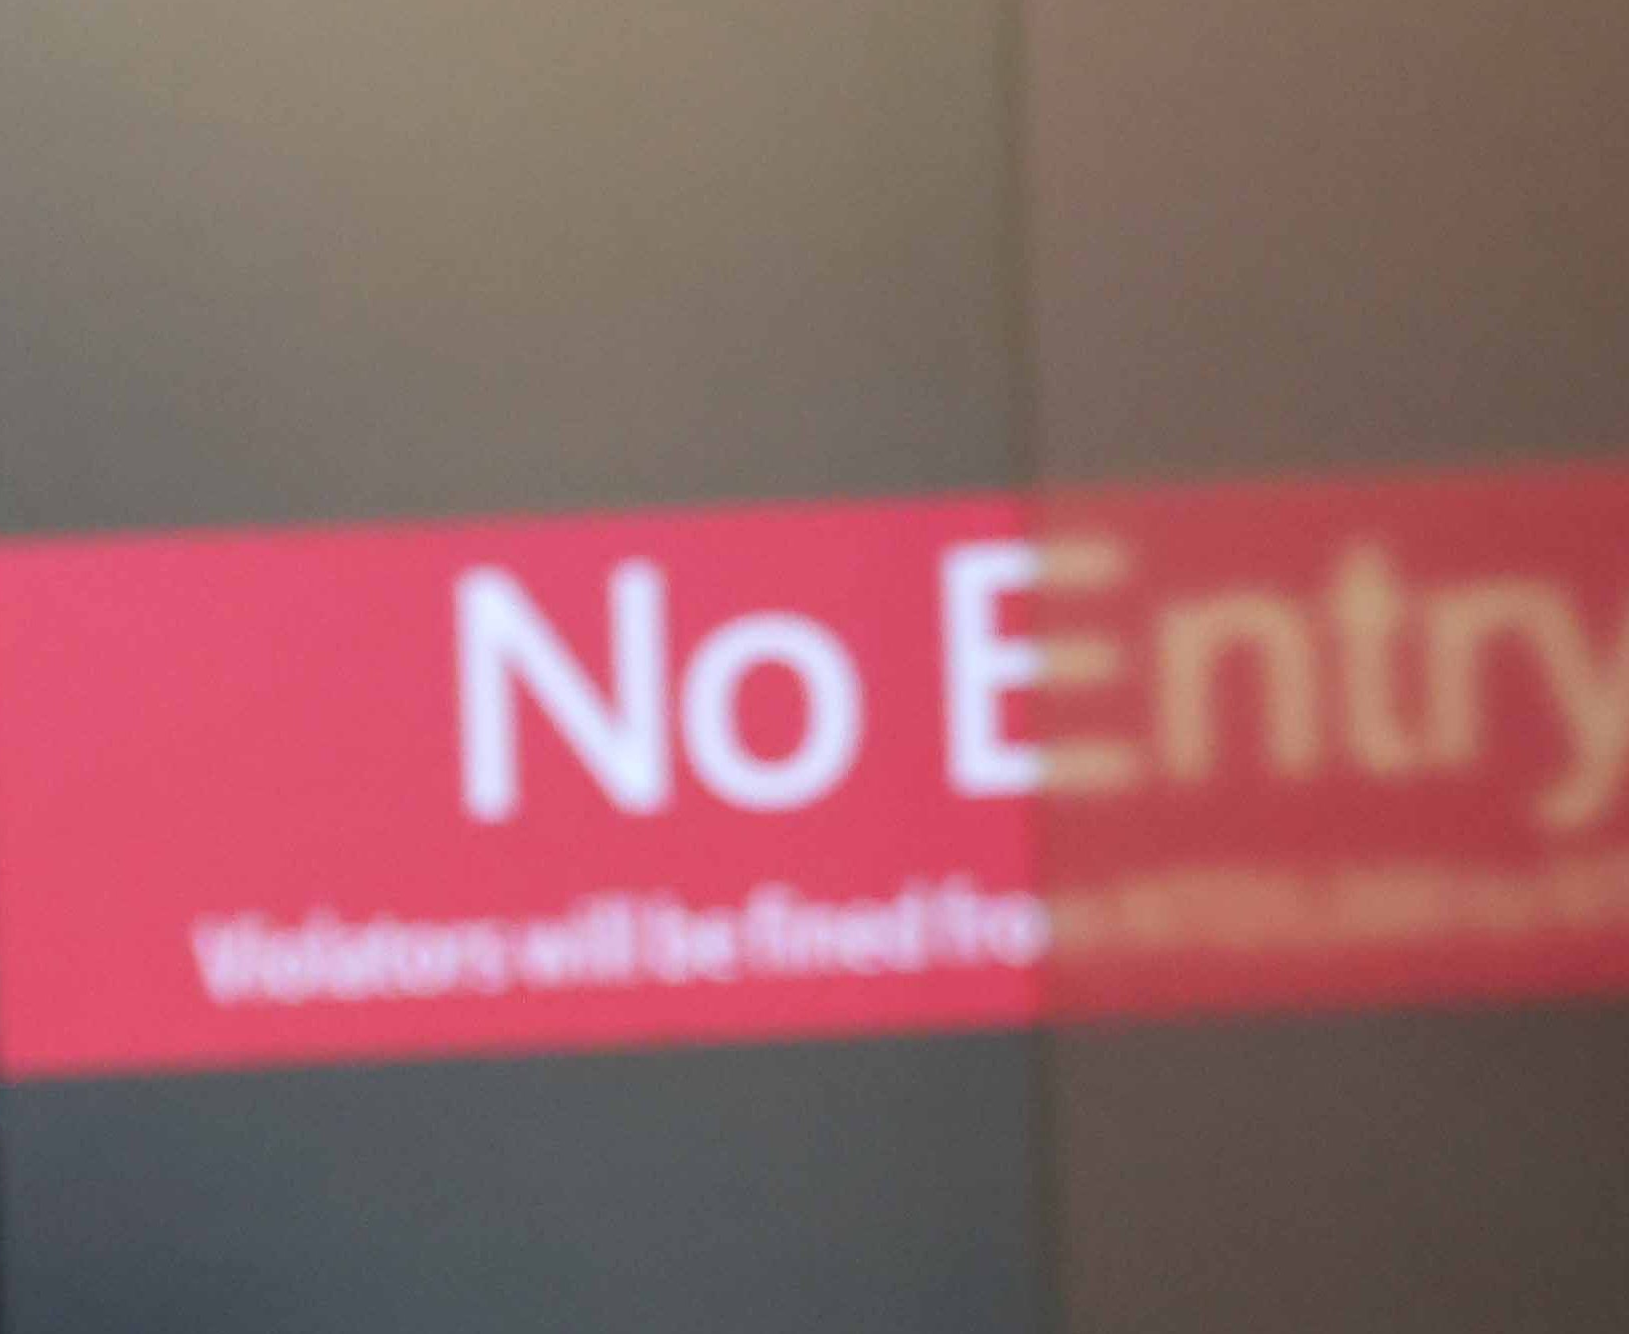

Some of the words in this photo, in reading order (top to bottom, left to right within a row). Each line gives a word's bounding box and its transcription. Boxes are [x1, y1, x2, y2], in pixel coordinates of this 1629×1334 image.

[458, 560, 862, 822] No
[941, 537, 1629, 830] Entry
[194, 910, 513, 1005] Violators
[644, 888, 738, 985] be
[747, 880, 932, 975] fined
